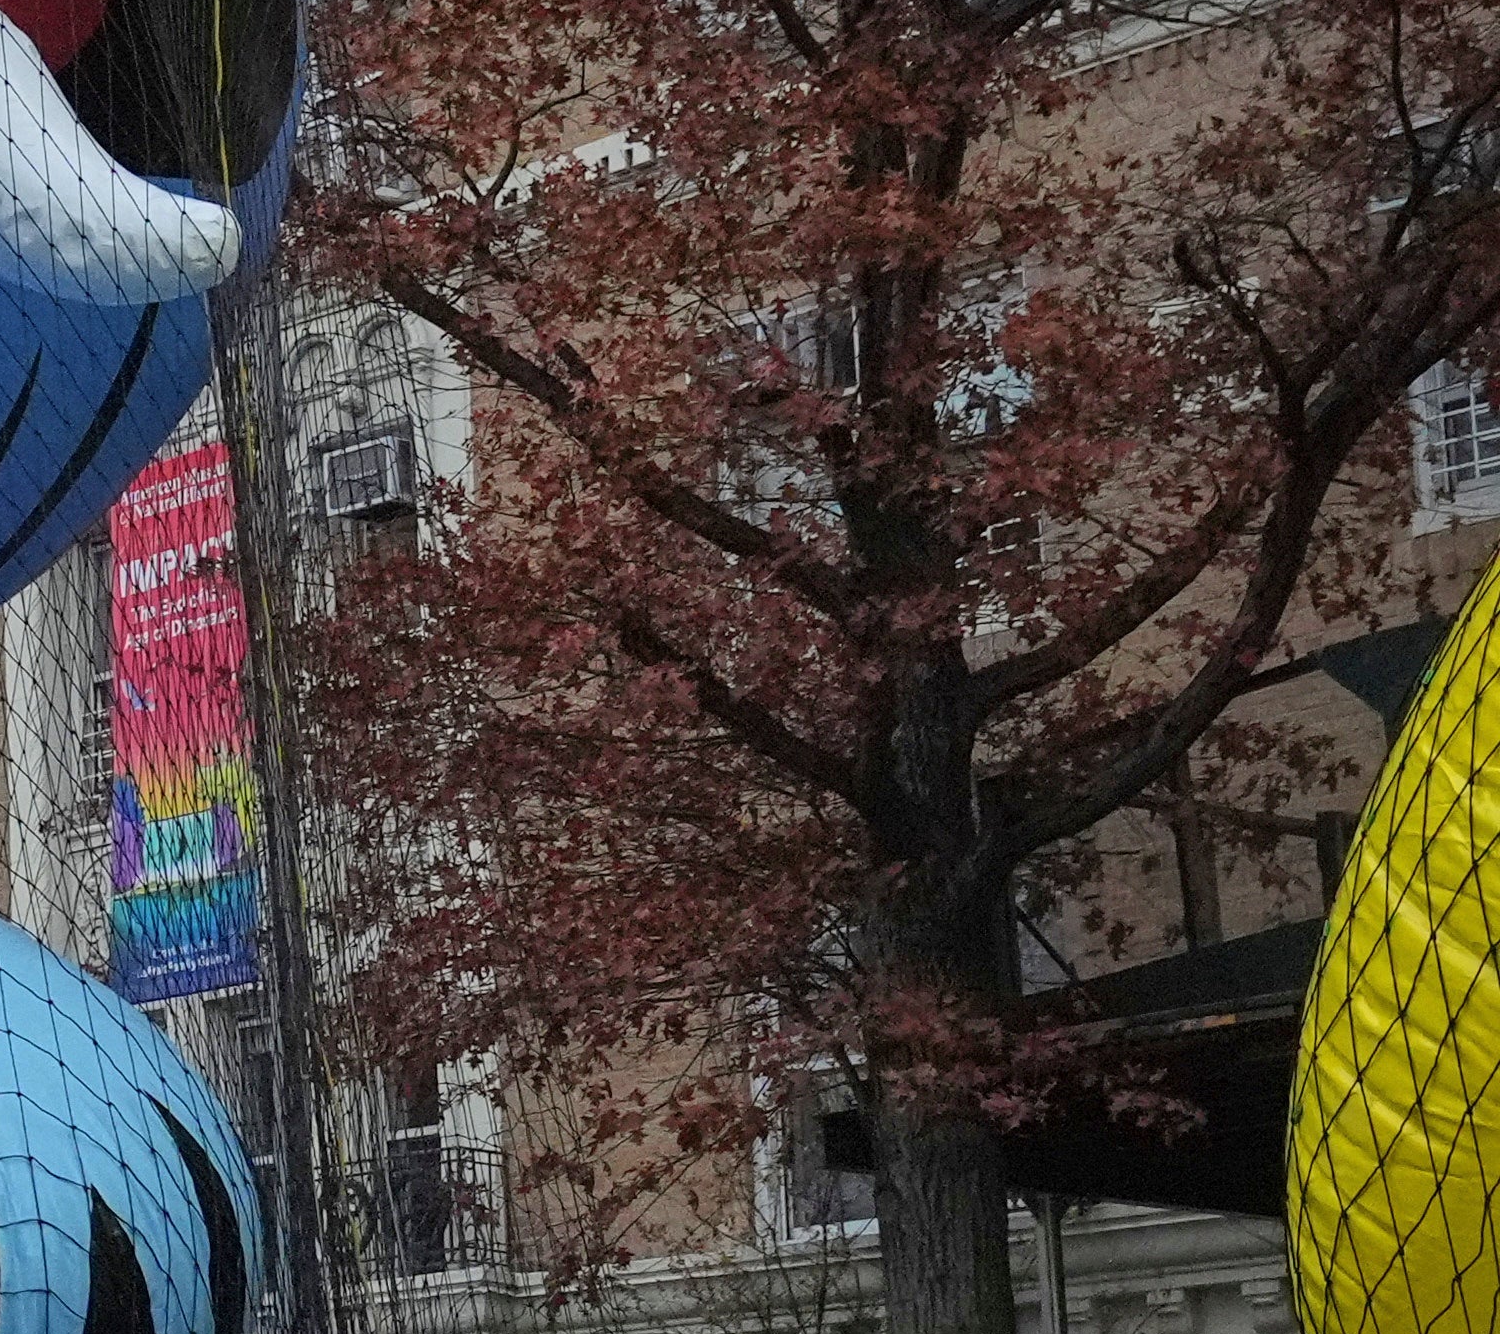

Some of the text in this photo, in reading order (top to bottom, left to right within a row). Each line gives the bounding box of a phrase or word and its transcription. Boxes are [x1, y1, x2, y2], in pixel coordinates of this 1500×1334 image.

[120, 461, 231, 506] American Museu
[132, 489, 182, 521] Natural
[119, 530, 235, 598] IMPACT
[124, 630, 149, 652] Age
[171, 606, 238, 637] Dinosaurs
[131, 605, 156, 624] The
[162, 593, 186, 616] End
